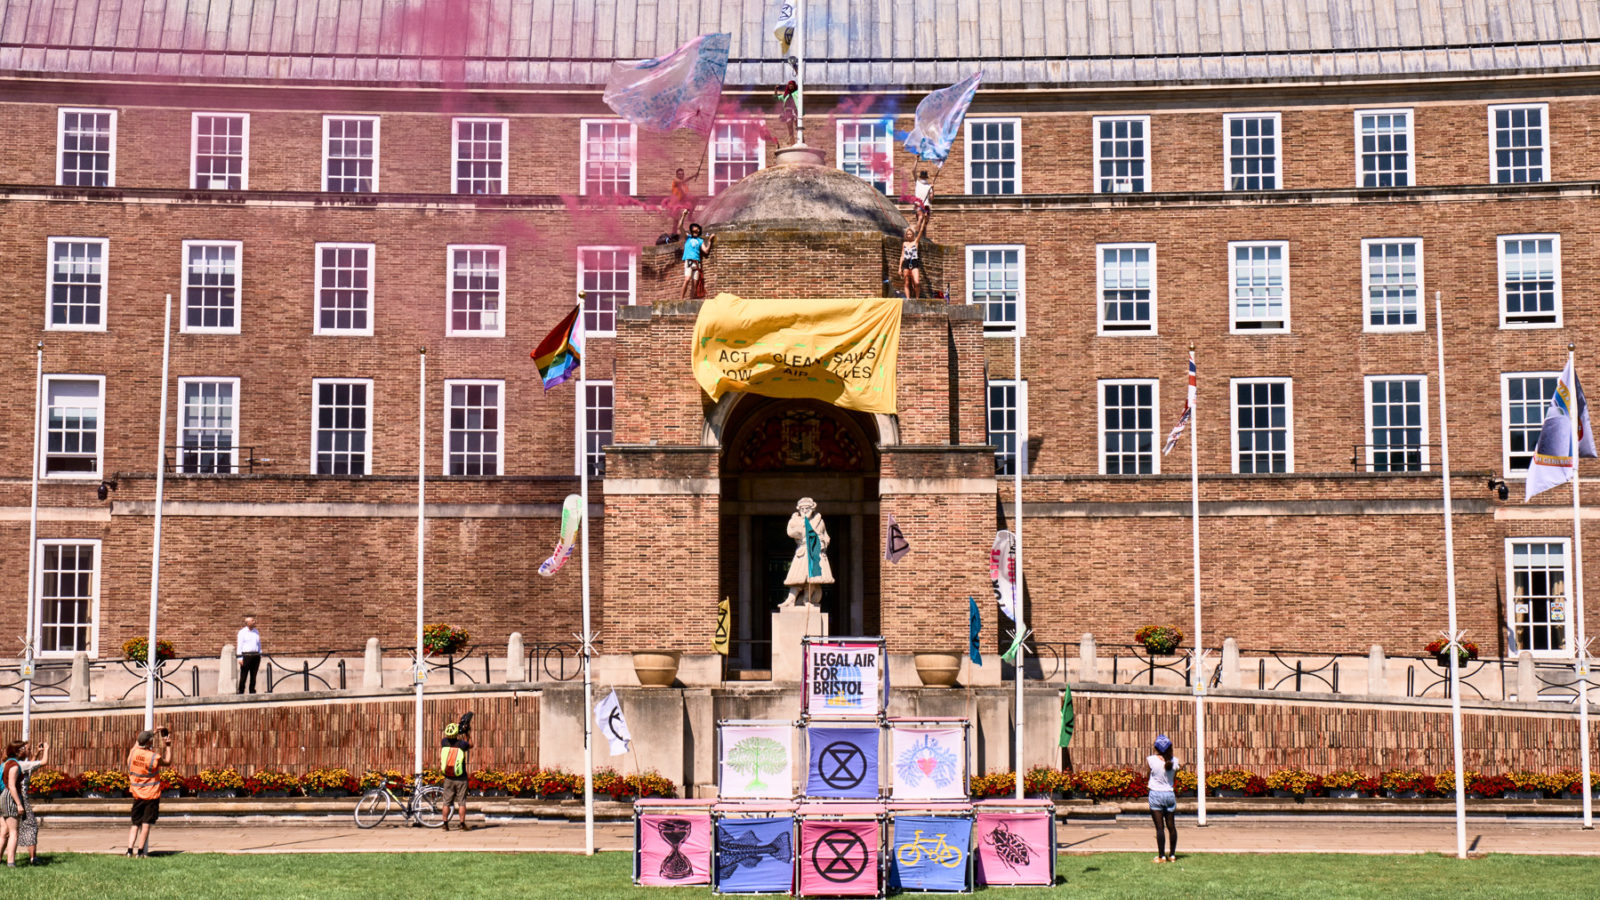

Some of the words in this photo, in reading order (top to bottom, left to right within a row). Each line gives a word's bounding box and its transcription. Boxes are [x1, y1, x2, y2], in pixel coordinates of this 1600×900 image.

[719, 349, 750, 363] ACT
[773, 353, 824, 368] CLEAN
[722, 369, 752, 381] OW
[813, 652, 850, 666] LEGAL
[853, 653, 875, 667] AIR
[813, 667, 838, 681] FOR
[813, 681, 864, 695] BRISTOL
